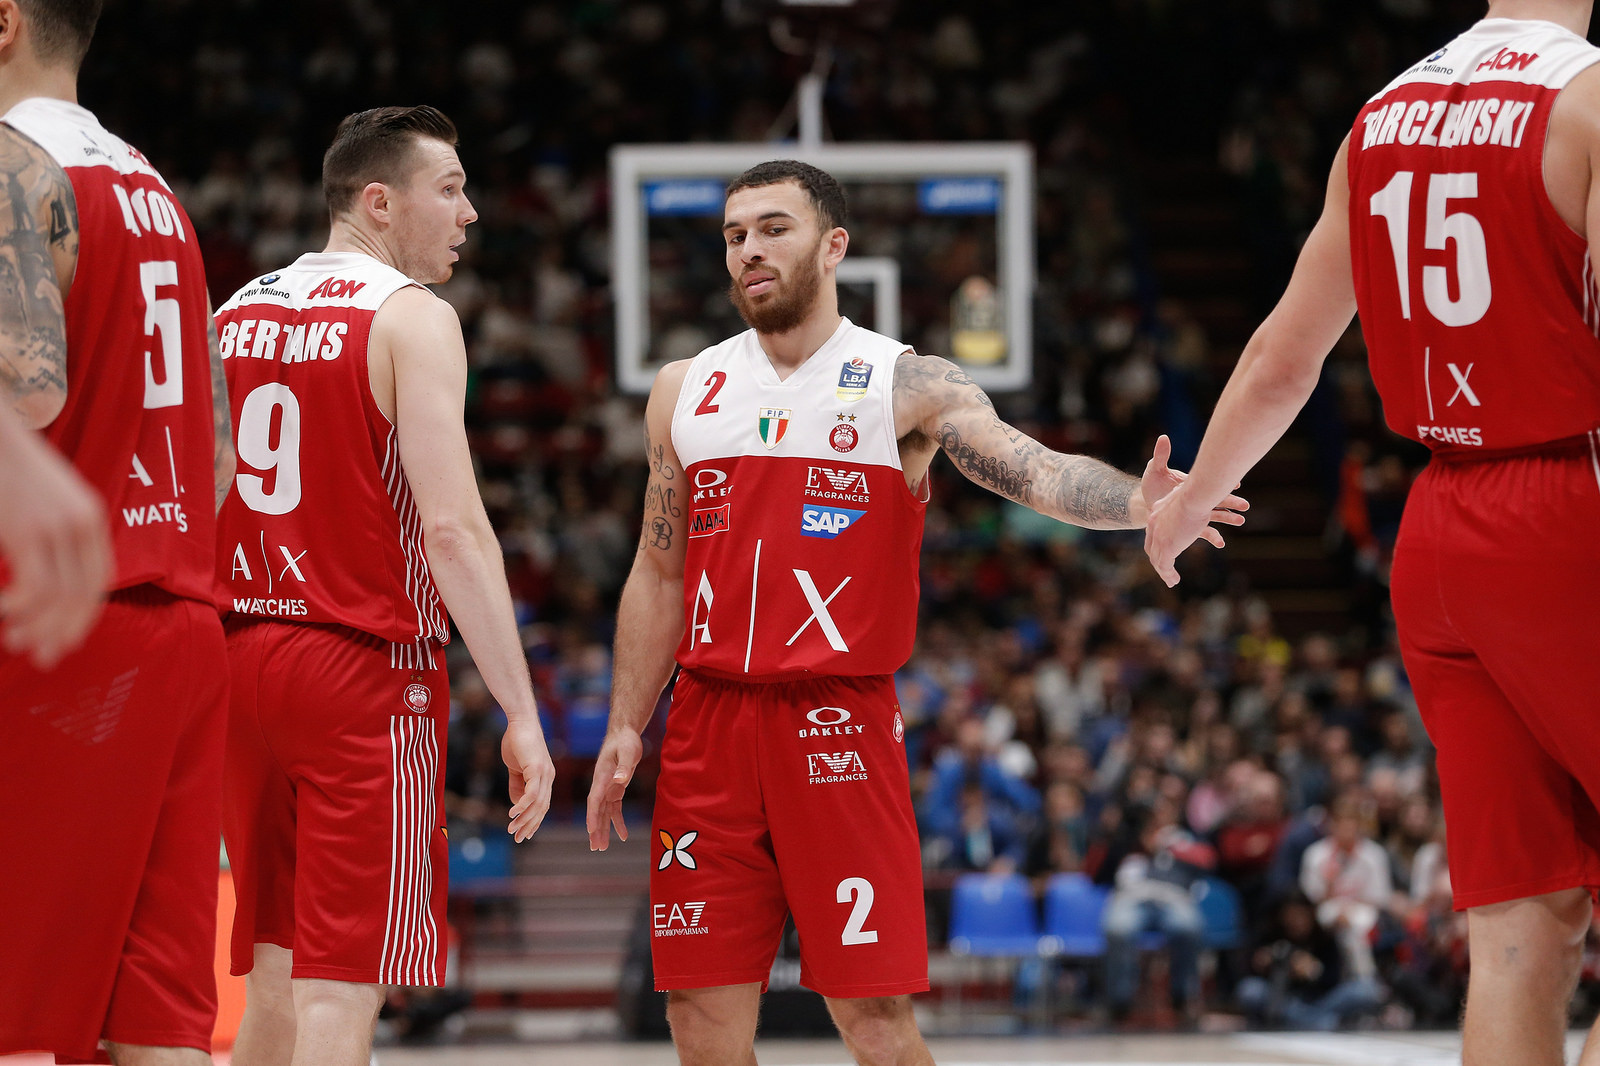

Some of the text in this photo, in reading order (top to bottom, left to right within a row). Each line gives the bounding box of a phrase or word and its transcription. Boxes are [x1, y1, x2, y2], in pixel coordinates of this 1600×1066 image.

[1421, 64, 1454, 75] Milano
[1476, 47, 1539, 72] AON
[1370, 171, 1492, 327] 15
[259, 287, 290, 299] Milano
[307, 276, 367, 300] AON
[139, 260, 184, 409] 5
[843, 373, 867, 383] LBA
[694, 371, 727, 416] 2
[767, 409, 784, 417] FIP
[236, 382, 301, 515] 9
[804, 489, 870, 503] FRAGRANCES
[801, 510, 850, 534] SAP
[232, 597, 308, 616] WATCHES
[799, 725, 863, 738] OAKLEY
[809, 773, 868, 785] FRAGRANCES
[653, 901, 707, 929] EA7
[836, 877, 878, 946] 2
